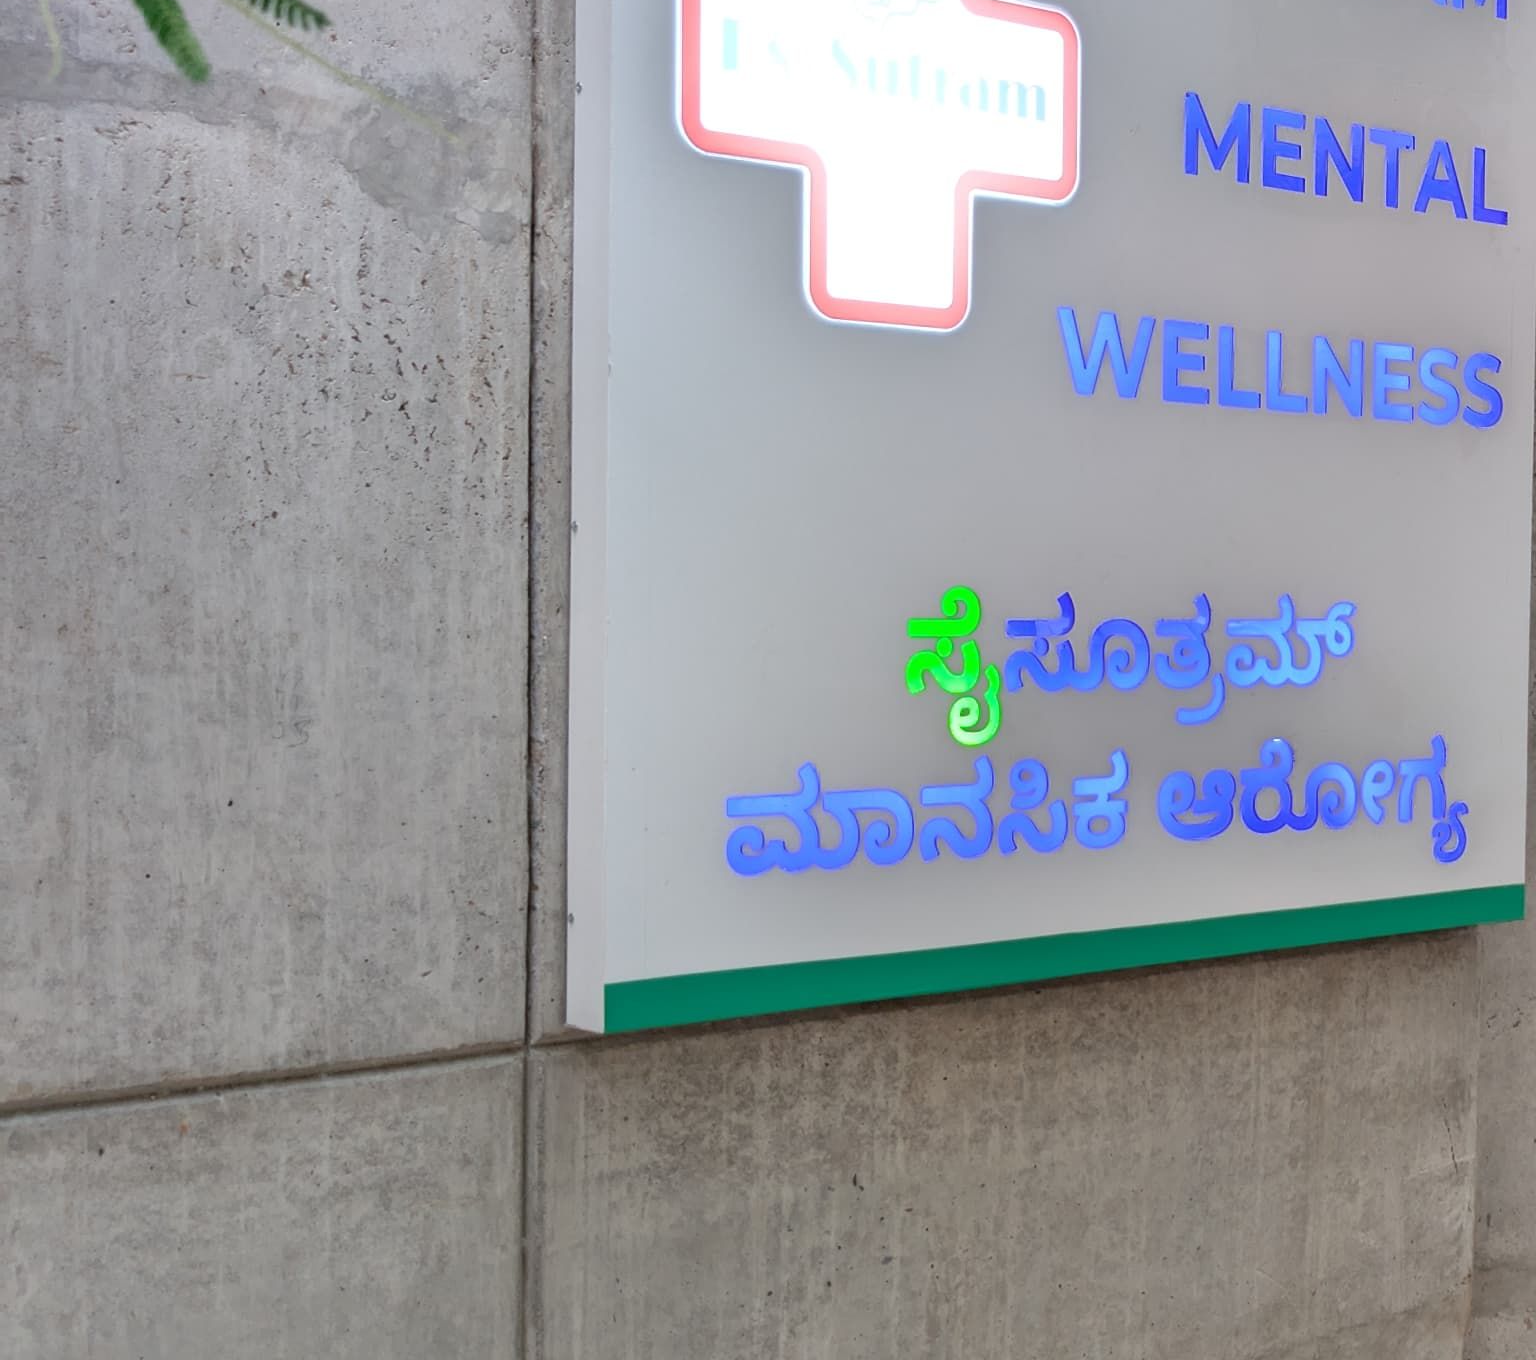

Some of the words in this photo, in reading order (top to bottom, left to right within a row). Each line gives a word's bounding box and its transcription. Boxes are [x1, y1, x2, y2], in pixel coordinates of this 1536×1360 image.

[1183, 91, 1509, 226] MENTAL
[1056, 305, 1504, 429] WELLNESS
[724, 747, 1131, 878] ಮಾನಸಿಕ
[1156, 734, 1470, 865] ಆರೋಗ್ಯ
